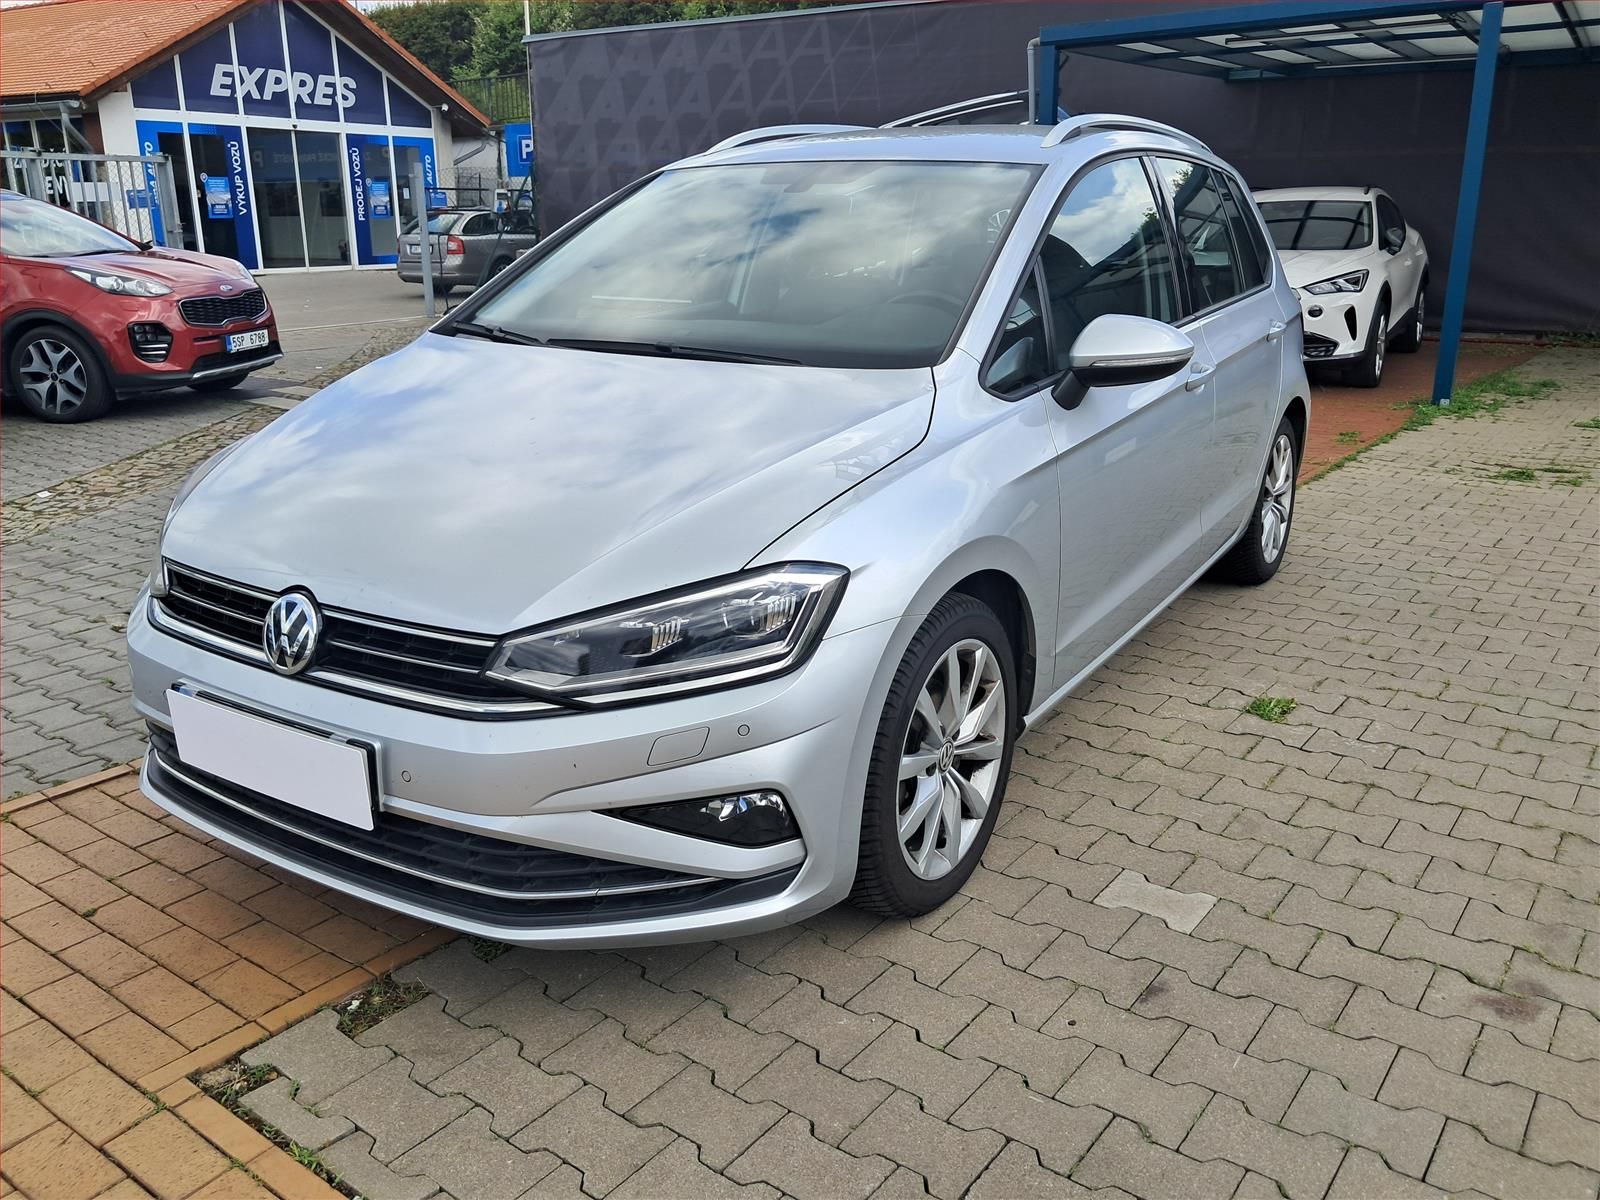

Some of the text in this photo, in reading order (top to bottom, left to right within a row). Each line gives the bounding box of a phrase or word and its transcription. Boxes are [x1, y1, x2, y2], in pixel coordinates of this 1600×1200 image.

[210, 63, 357, 108] EXPRES
[521, 139, 533, 159] P
[227, 141, 247, 215] VÝKUP VOZŮ
[349, 147, 366, 221] PRODEJ VOZŮ
[424, 155, 434, 184] AUTO
[232, 336, 245, 348] 5SP
